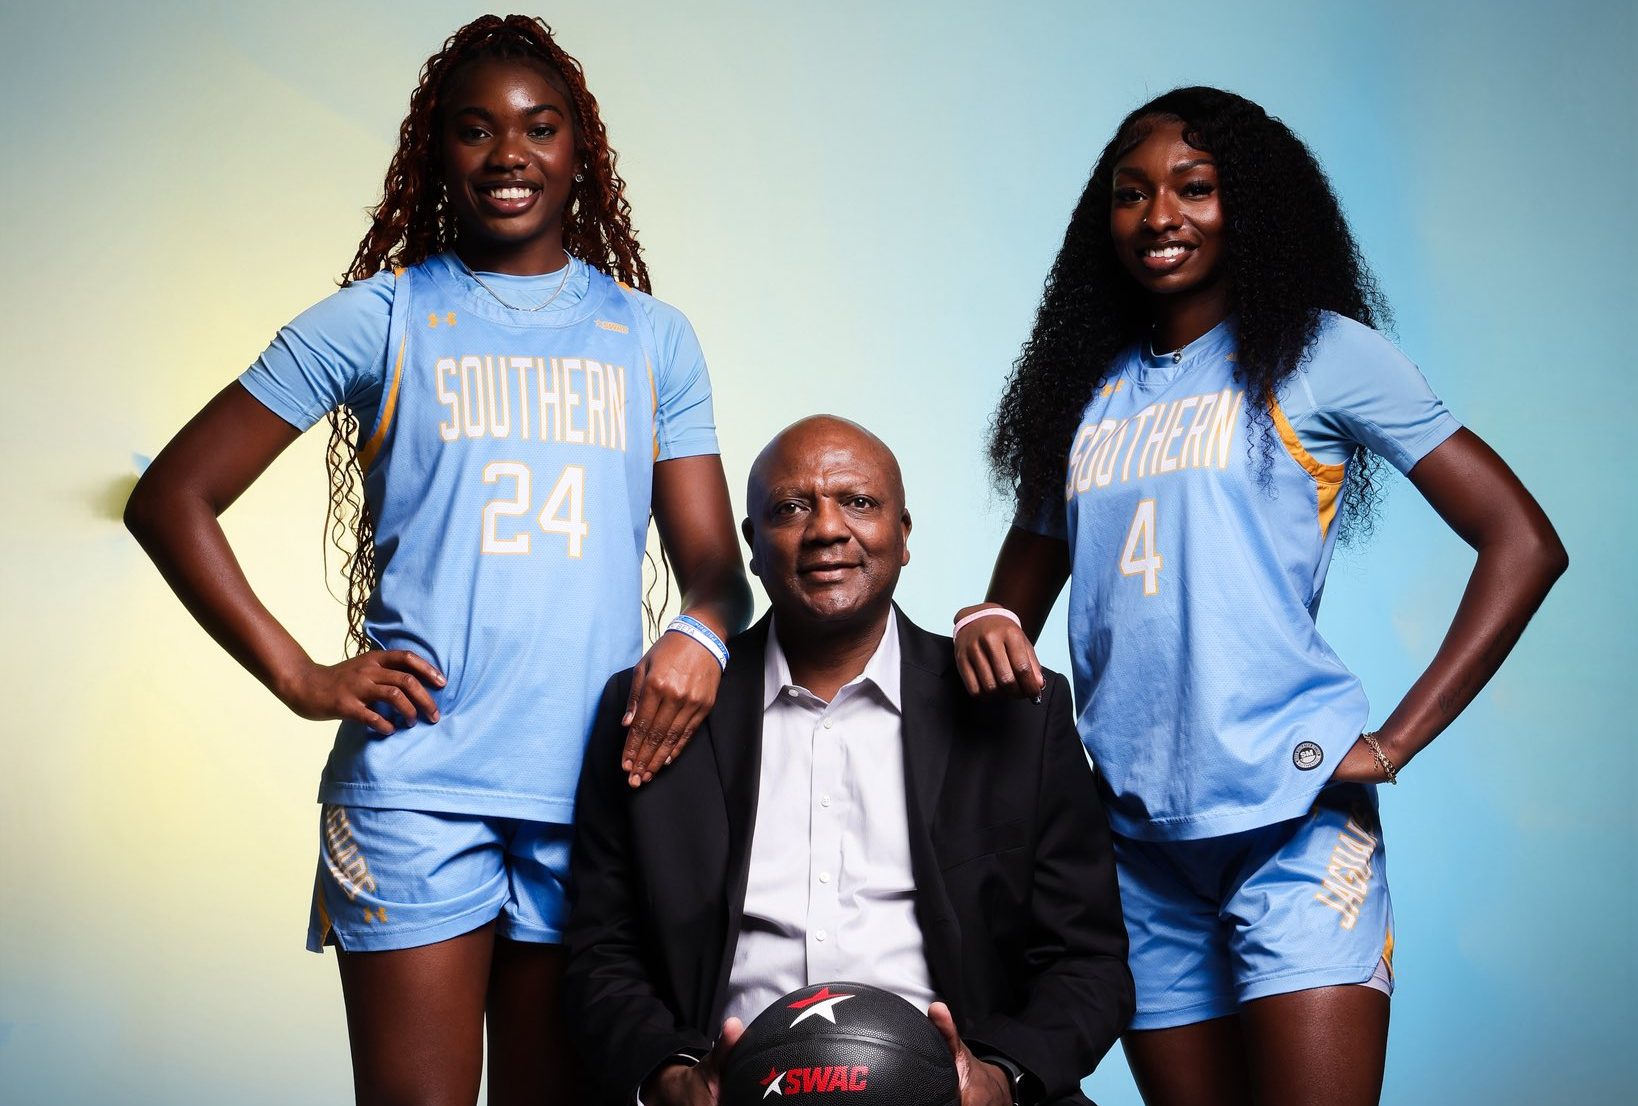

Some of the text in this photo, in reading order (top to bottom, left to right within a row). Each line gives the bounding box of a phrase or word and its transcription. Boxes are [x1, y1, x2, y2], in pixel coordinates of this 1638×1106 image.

[435, 354, 626, 452] SOUTHERN
[1066, 389, 1244, 501] SOUTHERN
[480, 460, 589, 560] 24
[1120, 497, 1164, 597] 4
[784, 1065, 870, 1096] SWAC
